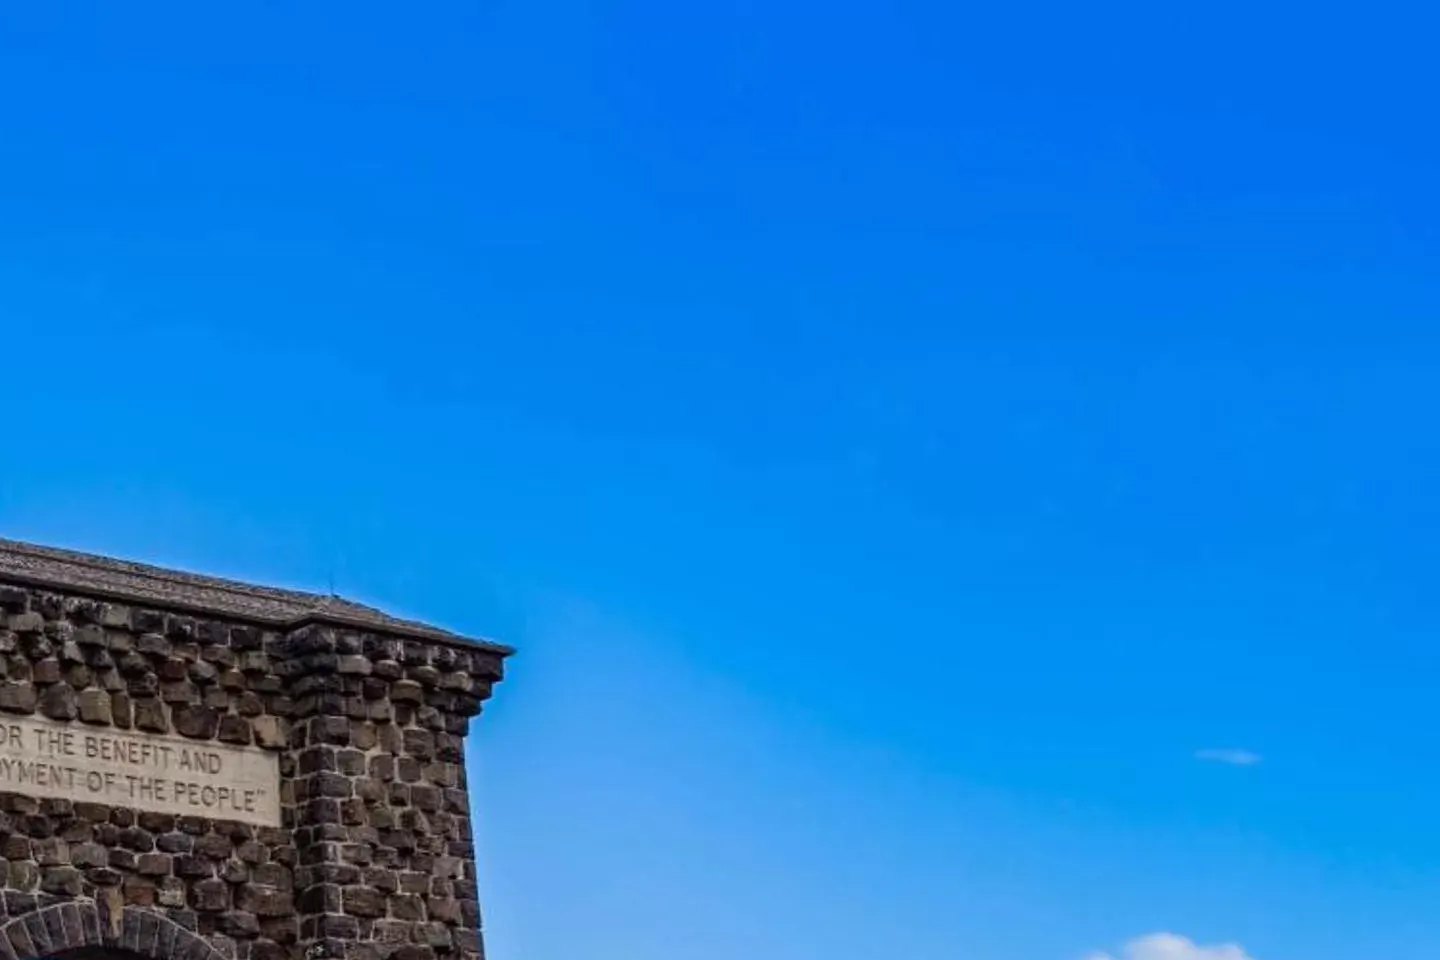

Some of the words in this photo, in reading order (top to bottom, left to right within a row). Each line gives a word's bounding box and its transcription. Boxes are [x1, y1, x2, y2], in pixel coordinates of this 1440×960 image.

[33, 728, 75, 756] THE
[85, 736, 172, 767] BENEFIT
[178, 749, 222, 775] AND
[86, 770, 116, 793] OF
[125, 775, 167, 802] THE
[174, 781, 266, 812] PEOPLE"
